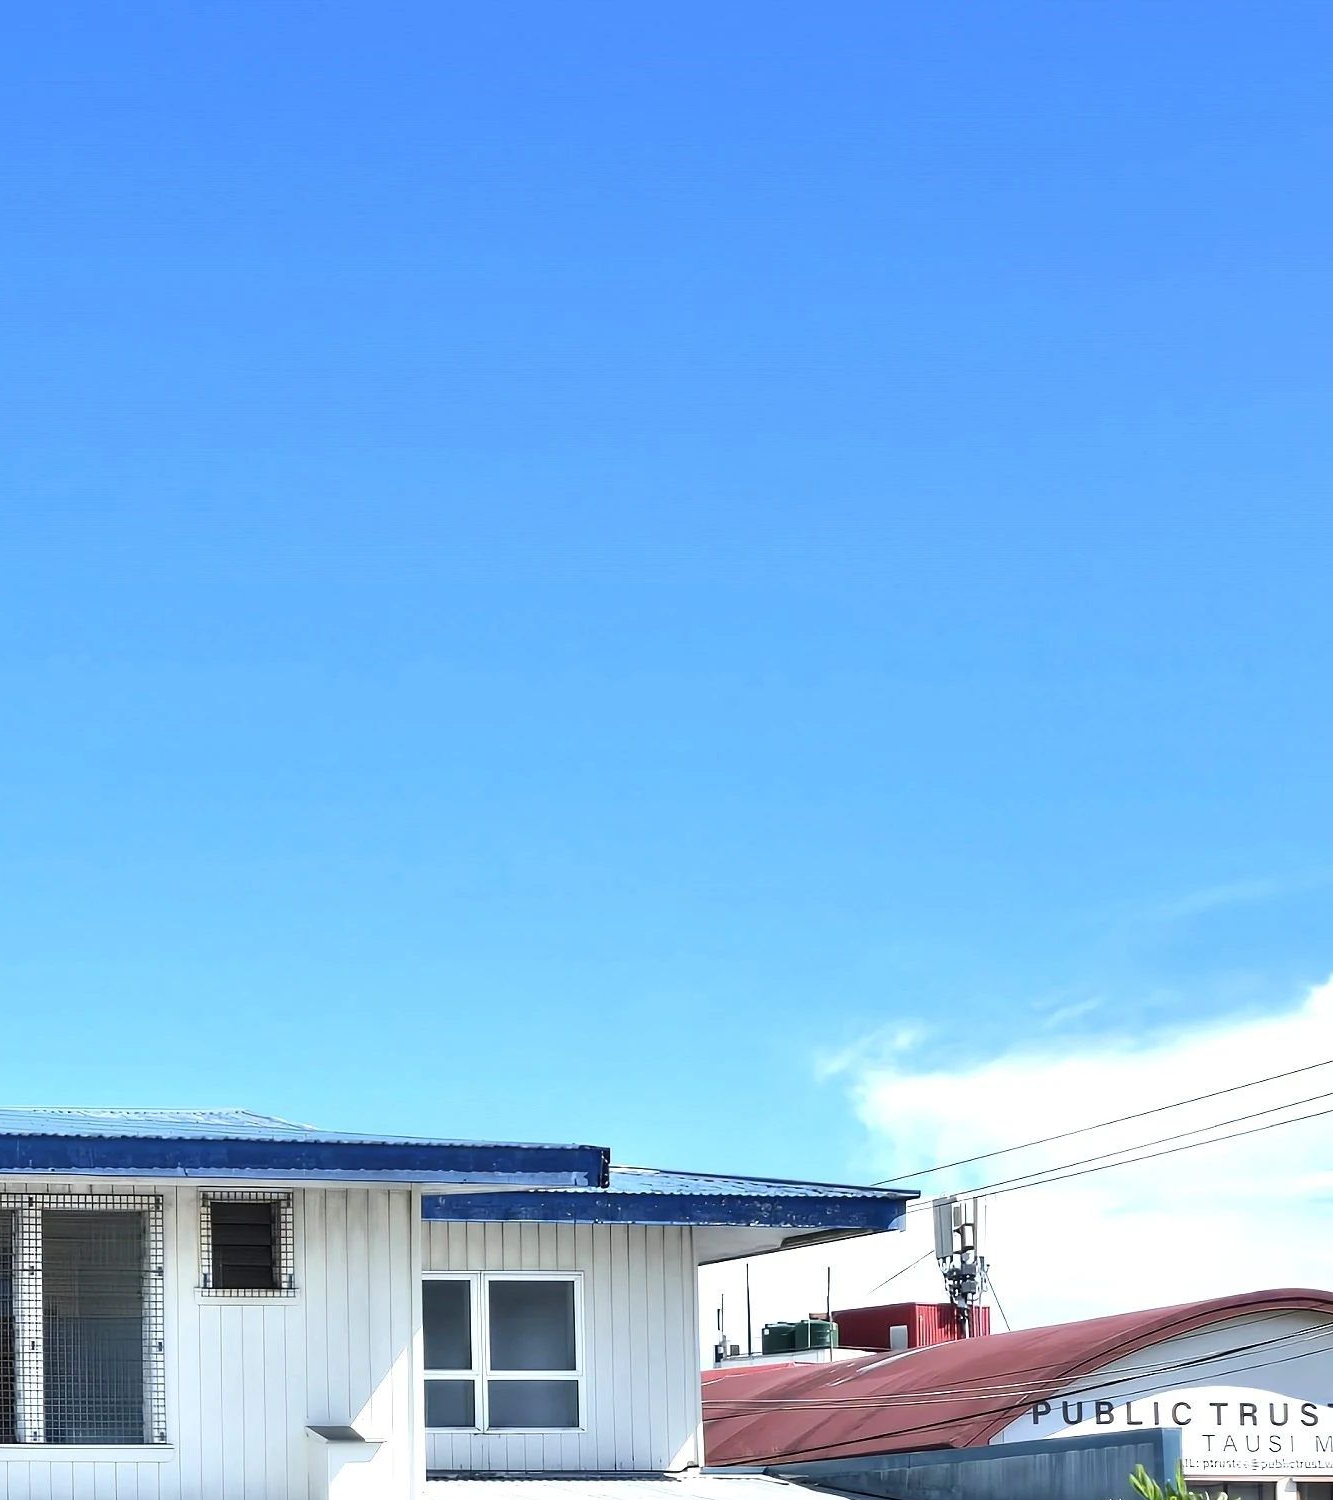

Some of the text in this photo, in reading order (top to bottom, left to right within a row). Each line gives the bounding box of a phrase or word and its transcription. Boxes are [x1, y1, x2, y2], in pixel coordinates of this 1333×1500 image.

[1032, 1401, 1333, 1427] PUBLIC TRUS
[1201, 1434, 1294, 1453] TAUSI
